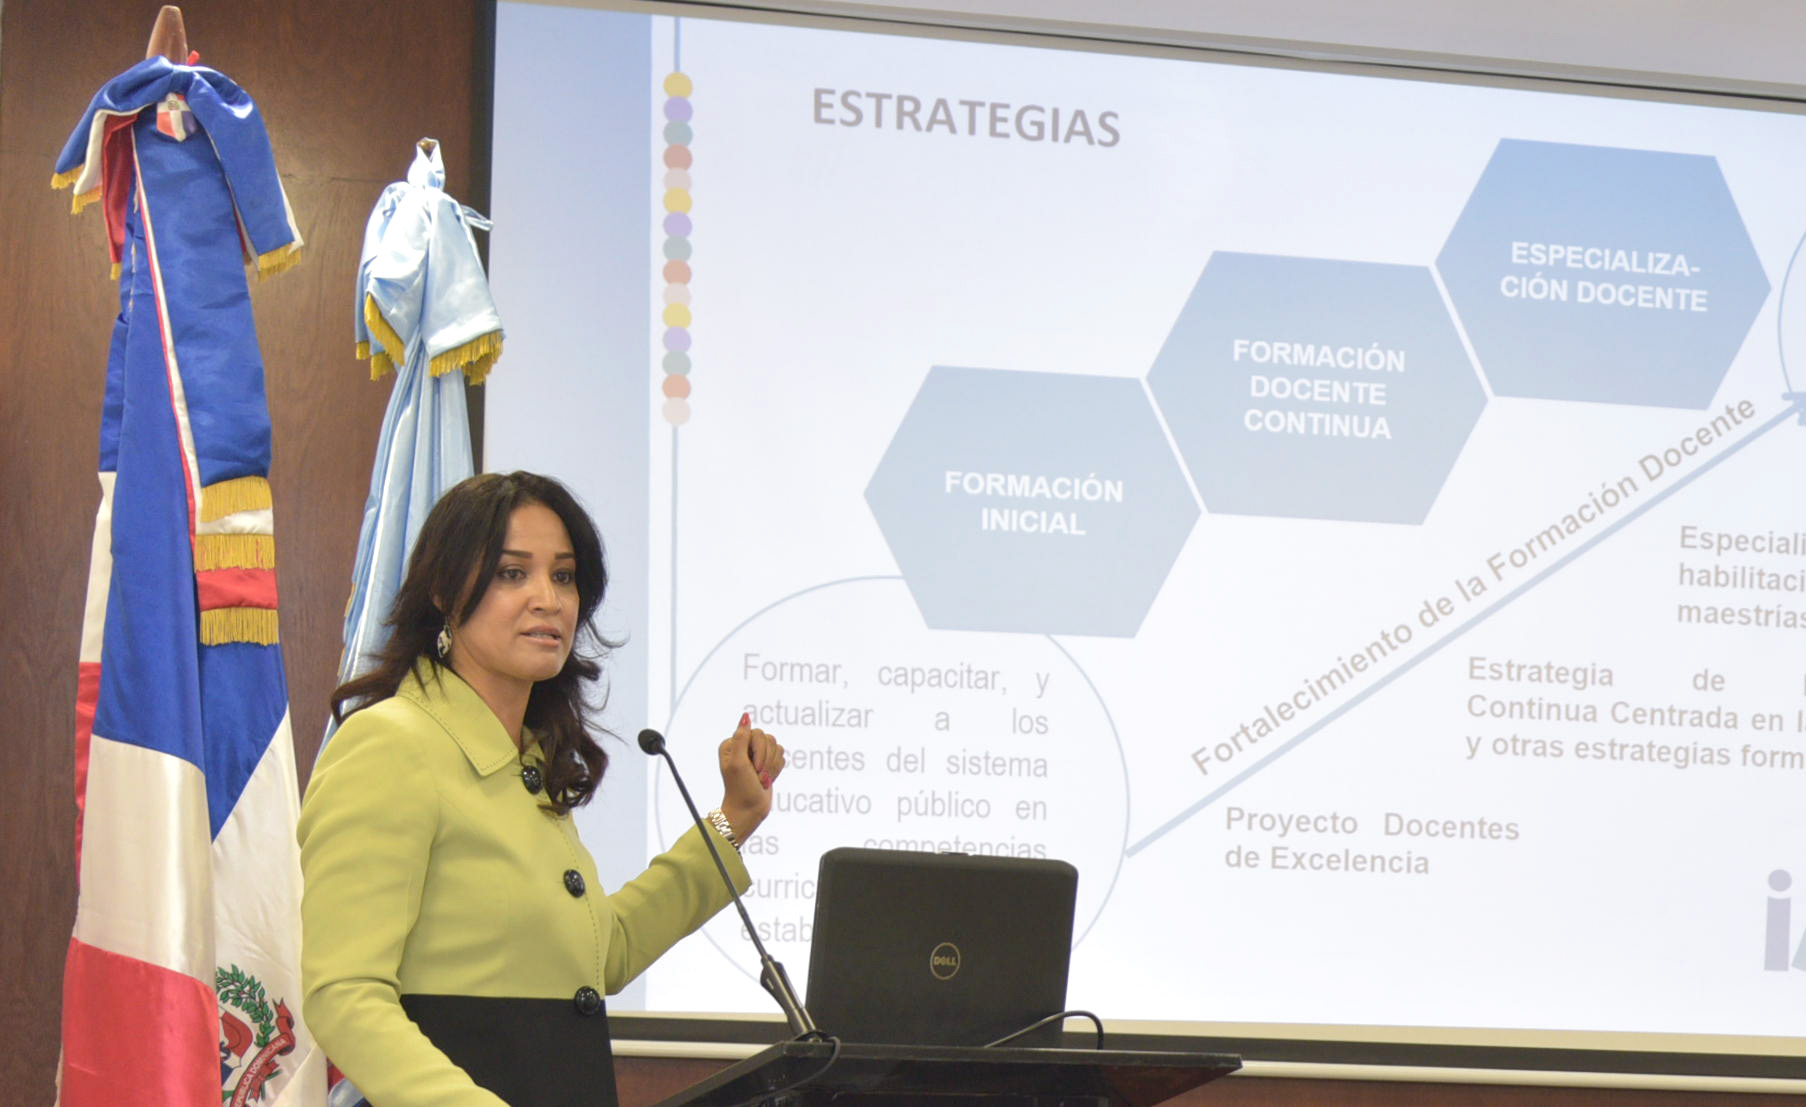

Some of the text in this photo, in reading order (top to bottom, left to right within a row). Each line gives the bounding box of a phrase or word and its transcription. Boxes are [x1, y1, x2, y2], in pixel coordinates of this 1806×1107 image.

[812, 86, 1121, 149] ESTRATEGIAS
[1511, 242, 1700, 277] ESPECIALIZA-
[1500, 271, 1709, 312] CIÓN DOCENTE
[1233, 339, 1405, 372] FORMACIÓN
[1250, 375, 1387, 405] DOCENTE
[1244, 409, 1392, 439] CONTINUA
[945, 470, 1124, 504] FORMACIÓN
[981, 508, 1086, 537] INICIAL
[1191, 398, 1756, 777] Fortalecimiento Formación Docente
[742, 653, 1007, 695] Formar, capacitar,
[1469, 656, 1615, 692] Estrategia
[1692, 668, 1726, 693] de
[742, 699, 1049, 735] actualizar los
[1466, 694, 1599, 725] Continua
[1611, 701, 1739, 731] Centrada
[886, 746, 1048, 778] del sistema
[1492, 734, 1566, 760] otras
[1573, 735, 1732, 770] estrategias
[897, 789, 1047, 822] público en
[1225, 807, 1520, 841] Proyecto Docentes
[1270, 845, 1430, 874] Excelencia
[933, 954, 958, 968] DELL
